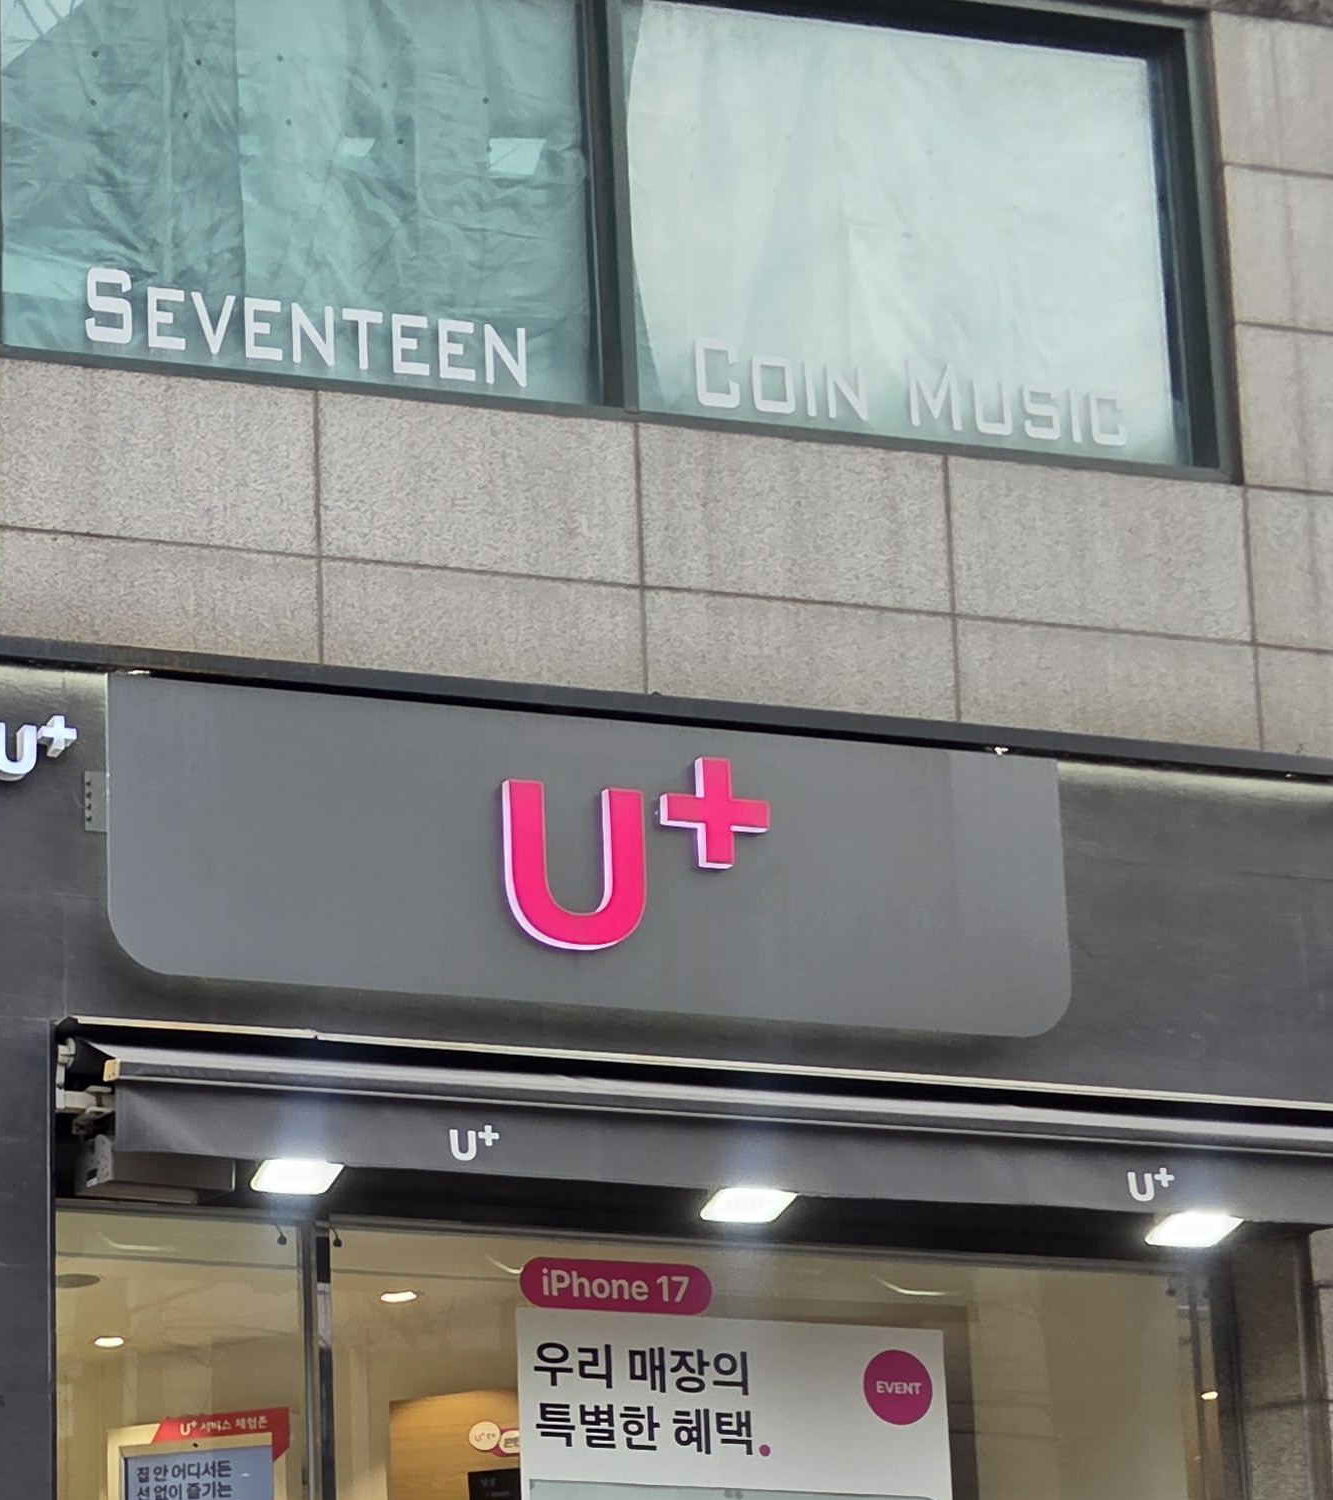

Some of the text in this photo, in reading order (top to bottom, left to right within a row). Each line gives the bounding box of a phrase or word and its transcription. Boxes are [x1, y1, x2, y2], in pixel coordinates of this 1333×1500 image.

[500, 756, 771, 951] U+
[448, 1125, 501, 1161] U+
[1127, 1166, 1176, 1203] U+
[541, 1268, 690, 1304] iPhone 17
[532, 1342, 750, 1396] 우리 매장의
[875, 1379, 922, 1397] EVENT
[535, 1403, 772, 1458] 특별한 혜택.
[137, 1460, 232, 1483] 집 안 어디서든
[153, 1484, 182, 1500] 없이
[186, 1481, 233, 1500] 즐기는
